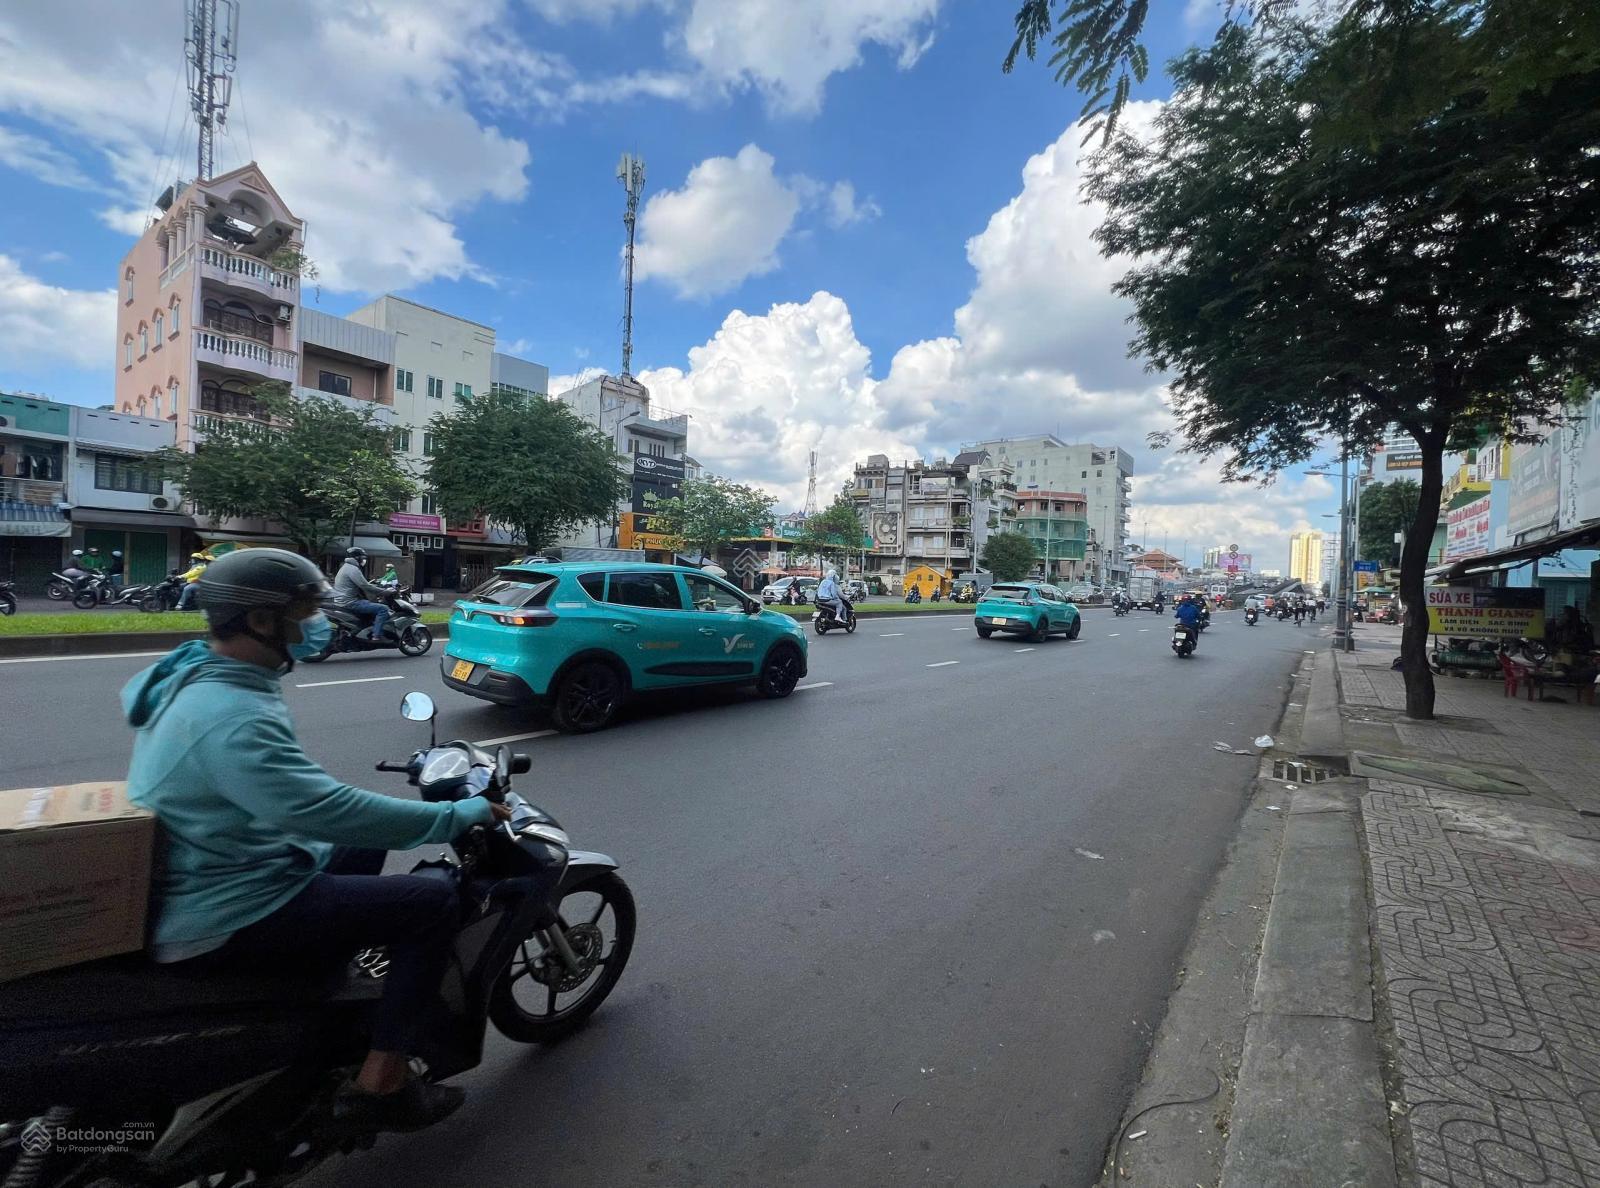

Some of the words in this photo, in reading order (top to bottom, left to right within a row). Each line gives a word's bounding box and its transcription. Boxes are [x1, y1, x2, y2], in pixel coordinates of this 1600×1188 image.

[1429, 589, 1452, 604] SỬA
[1456, 592, 1471, 604] XE
[1487, 608, 1535, 618] GIANG
